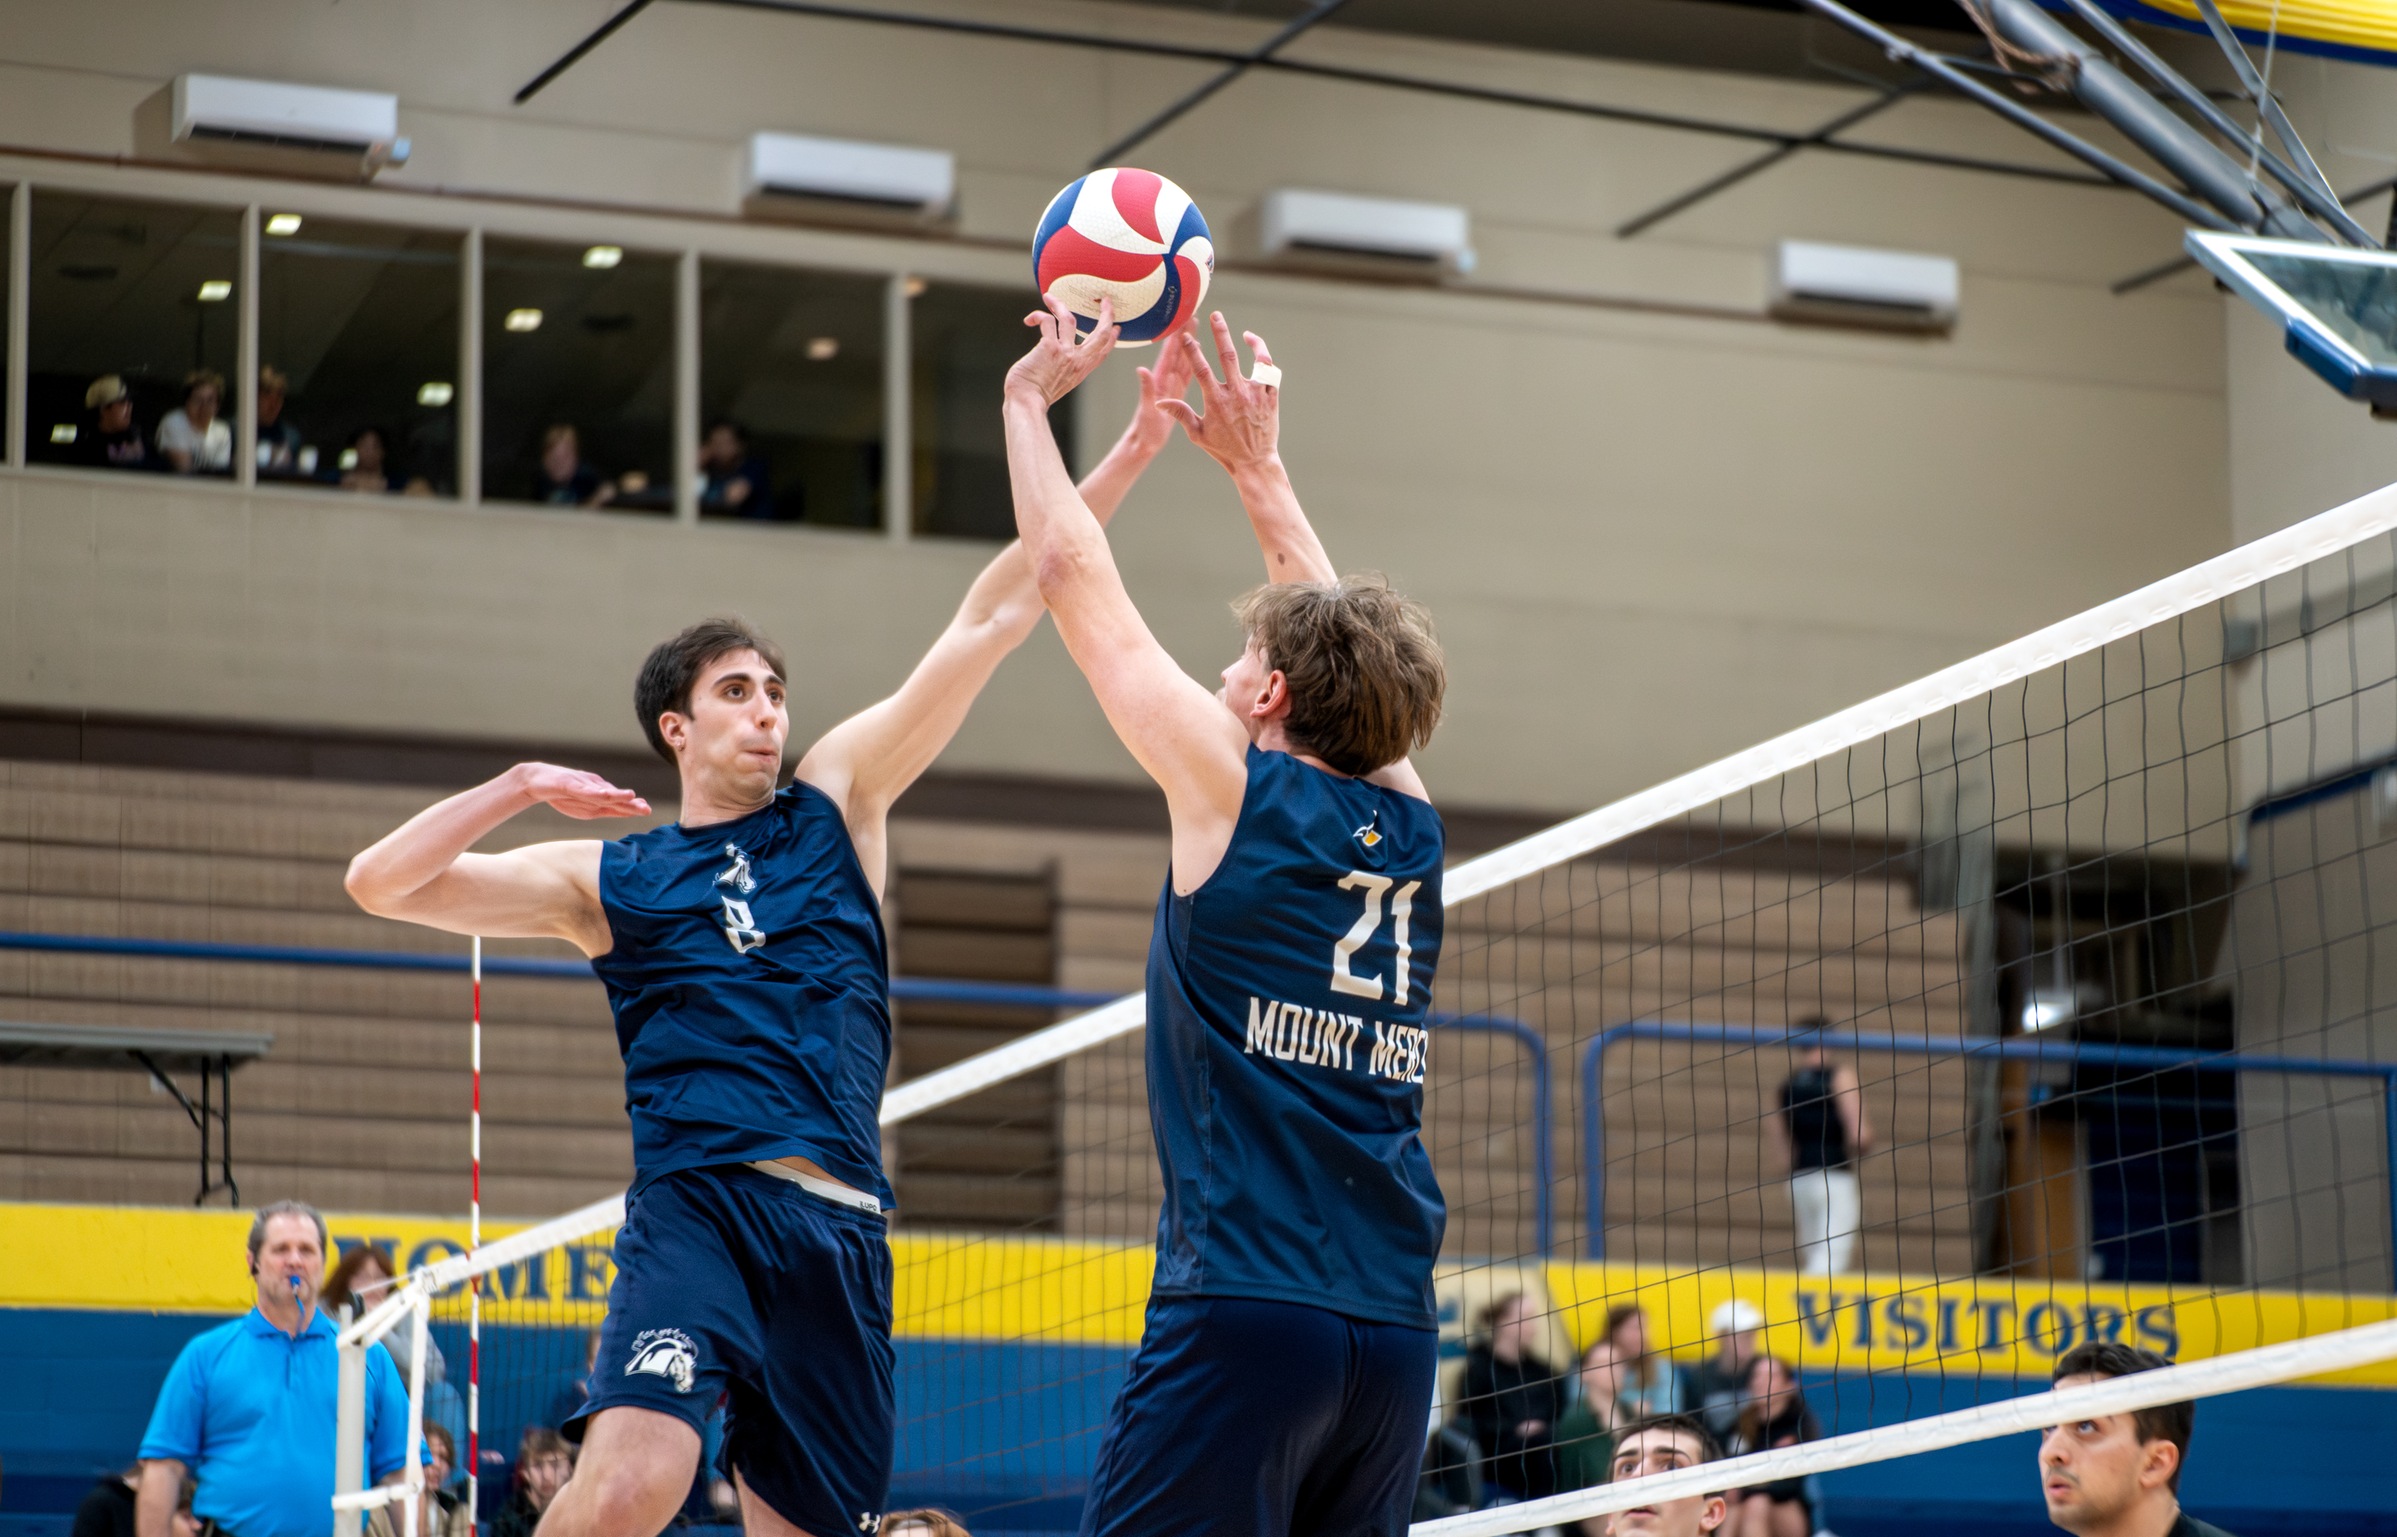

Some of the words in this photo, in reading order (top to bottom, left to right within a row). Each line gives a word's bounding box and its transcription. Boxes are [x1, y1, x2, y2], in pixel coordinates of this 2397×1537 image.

[721, 895, 767, 955] 8
[1330, 870, 1422, 1006] 21
[1244, 996, 1363, 1071] MOUNT
[1368, 1020, 1429, 1084] MERC
[1794, 1289, 2180, 1358] VISITORS
